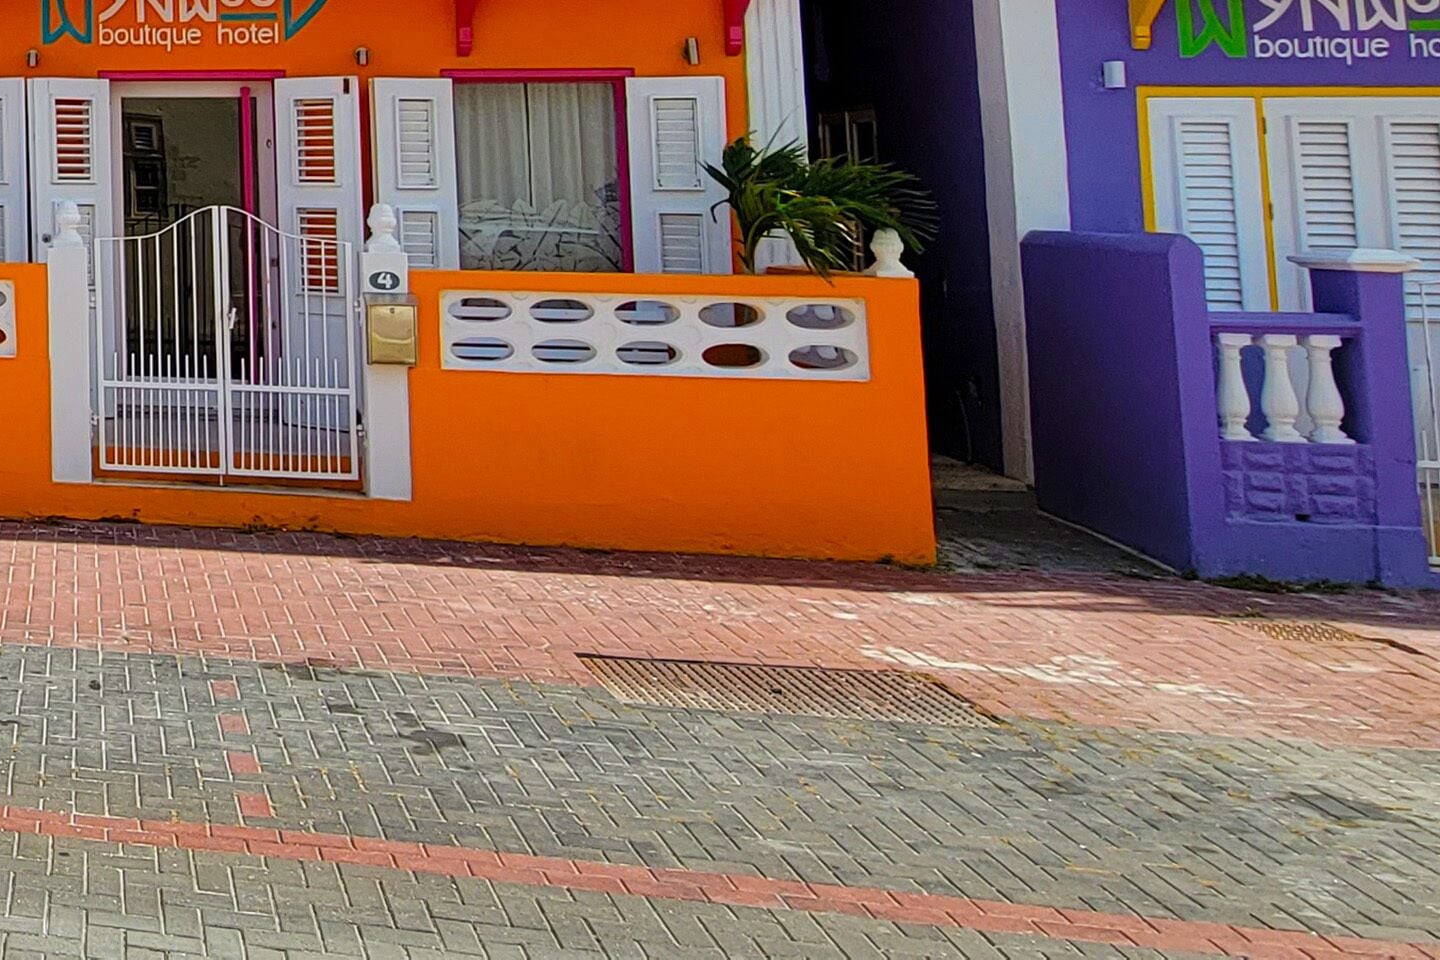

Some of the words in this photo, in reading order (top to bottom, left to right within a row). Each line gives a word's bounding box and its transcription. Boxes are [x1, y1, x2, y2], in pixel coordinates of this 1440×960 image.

[98, 23, 202, 52] boutique
[217, 22, 279, 45] hotel
[1254, 34, 1390, 65] boutique
[377, 272, 393, 289] 4
